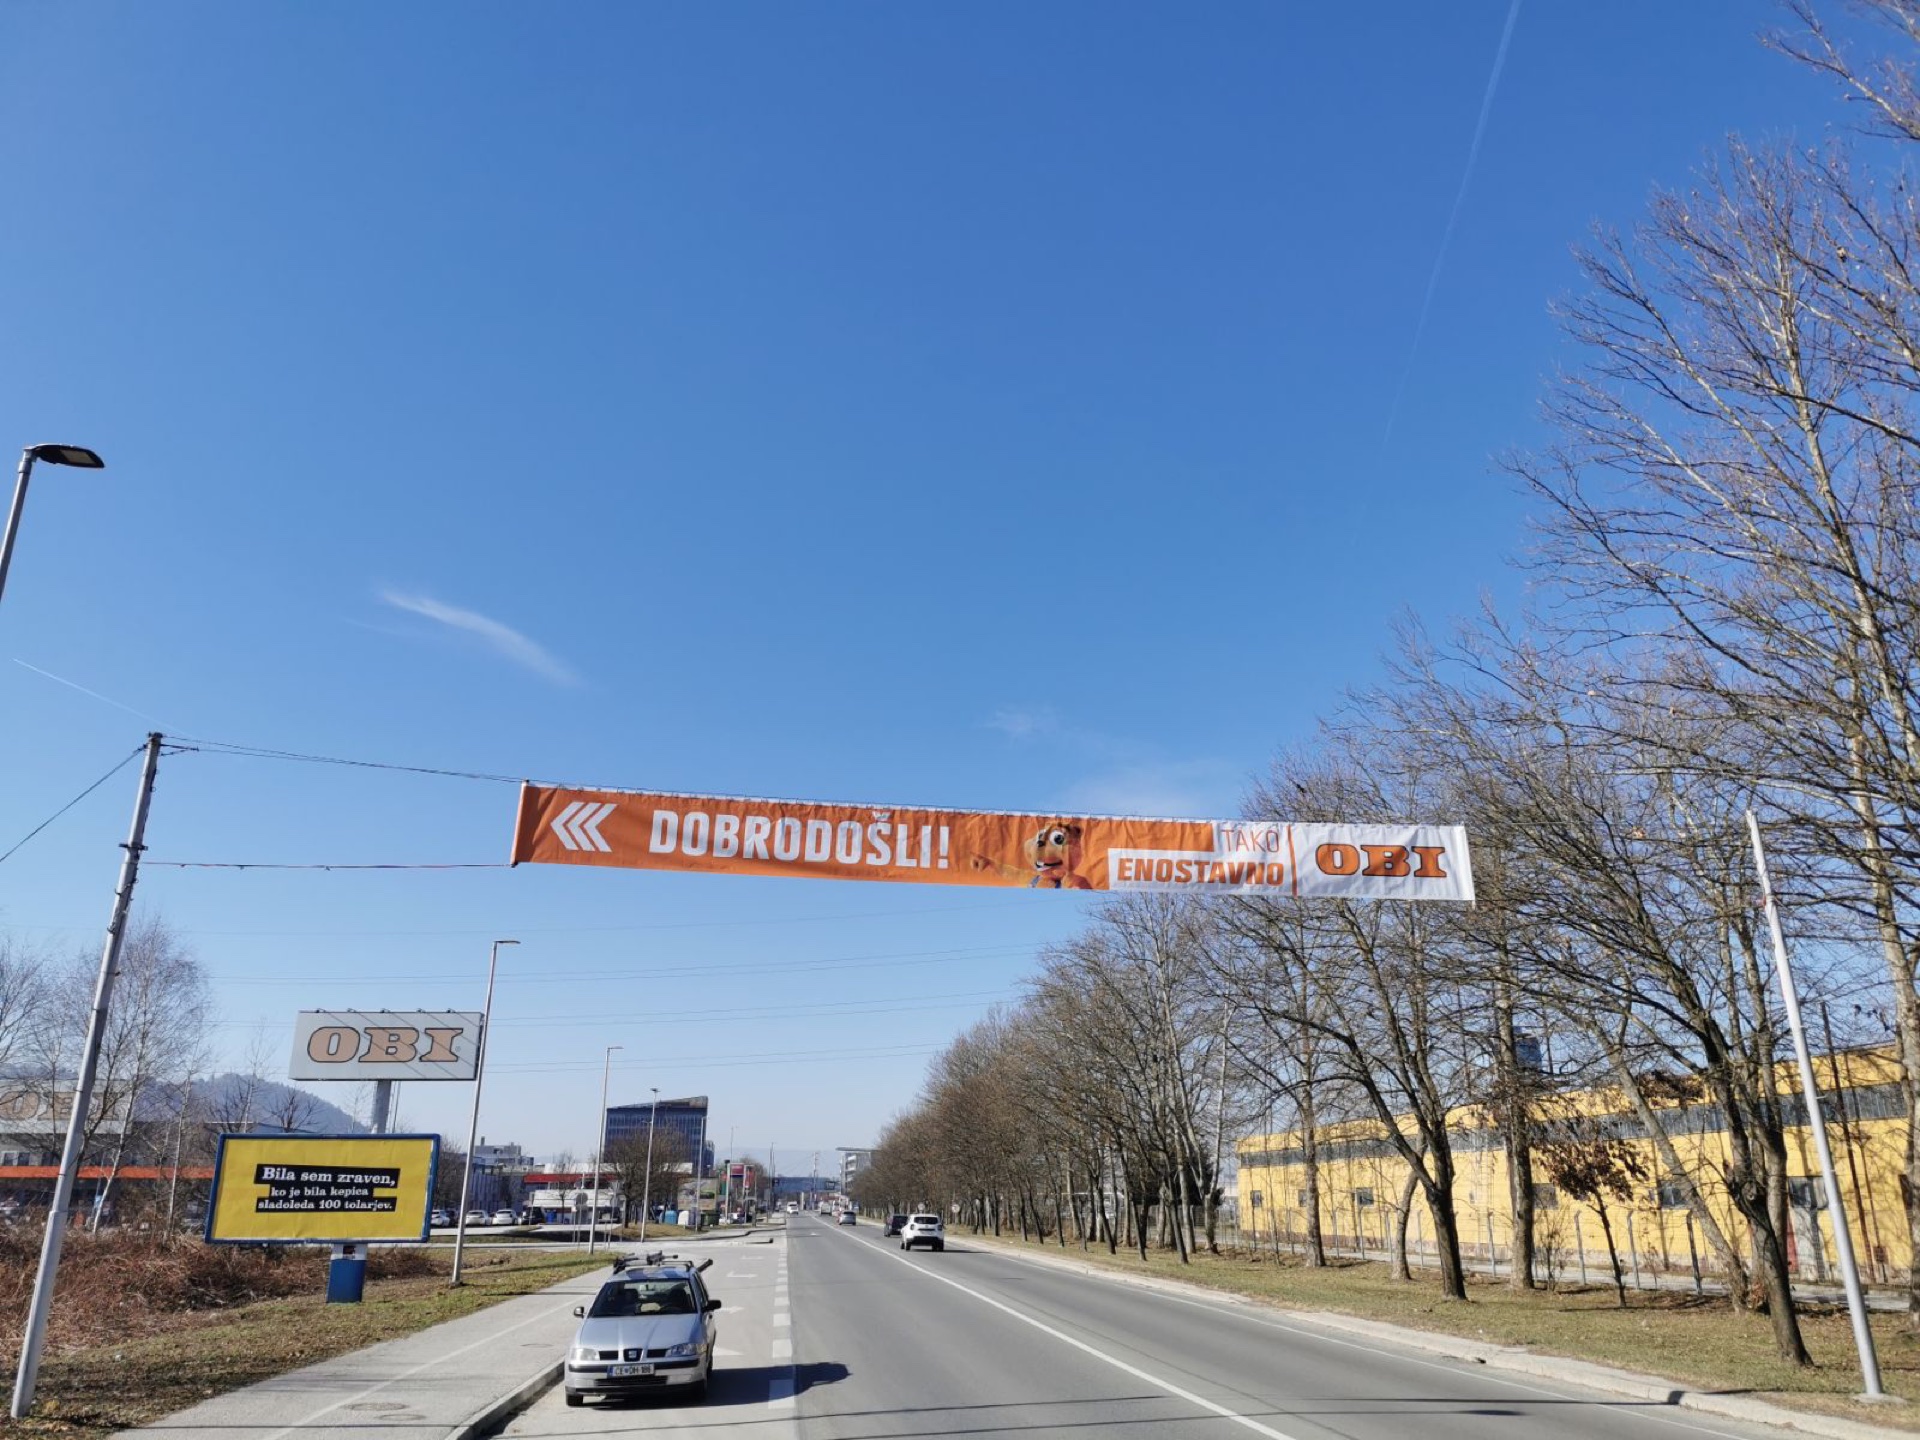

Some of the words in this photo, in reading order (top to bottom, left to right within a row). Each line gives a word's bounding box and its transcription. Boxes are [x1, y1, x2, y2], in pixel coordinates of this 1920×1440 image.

[649, 810, 949, 869] DOBRODOŠLI!
[1221, 829, 1279, 853] TAKO
[1117, 857, 1284, 887] ENOSTAVNO
[1315, 843, 1447, 878] OBI
[307, 1026, 464, 1062] OBI
[262, 1167, 295, 1181] Bila
[301, 1171, 332, 1182] sem
[337, 1173, 396, 1186] zraven,
[258, 1200, 315, 1209] sladoleda
[319, 1200, 340, 1209] 100
[345, 1200, 392, 1211] tolarjev.
[271, 1187, 286, 1196] ko
[289, 1187, 300, 1198] je
[304, 1187, 326, 1196] bila
[330, 1187, 369, 1198] kepica
